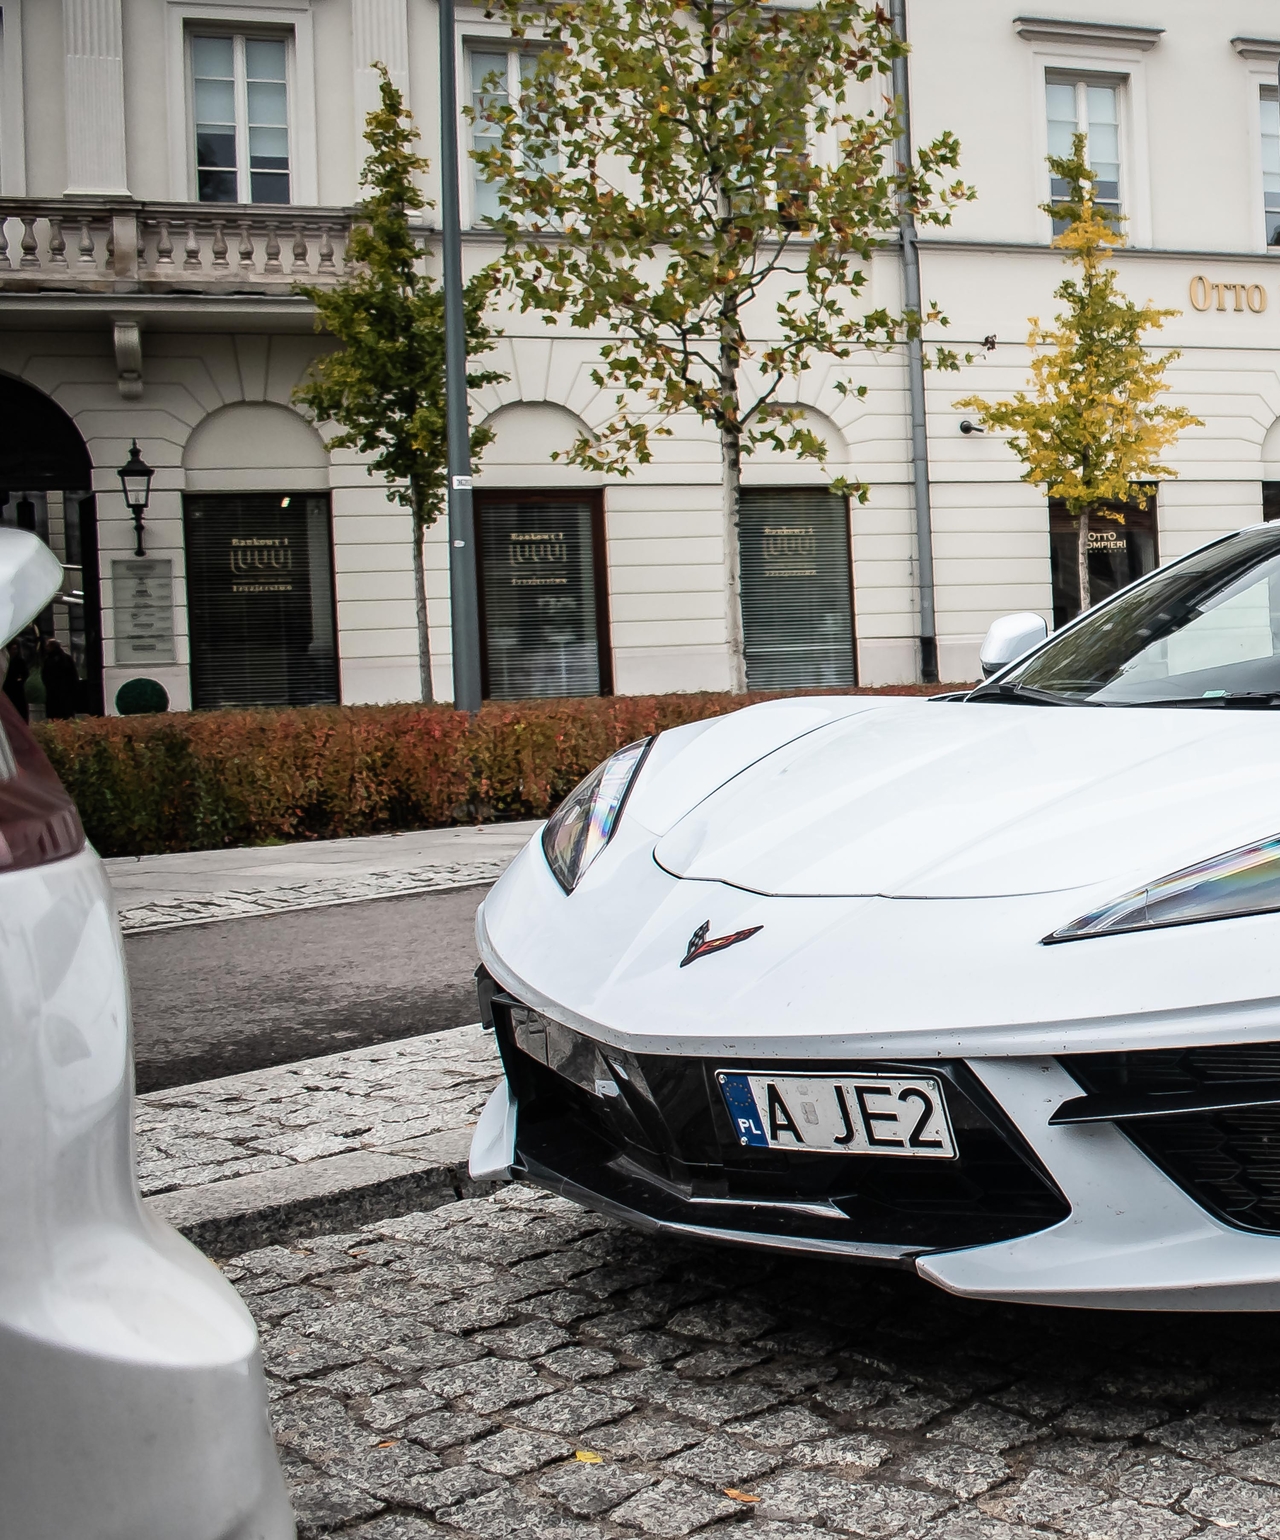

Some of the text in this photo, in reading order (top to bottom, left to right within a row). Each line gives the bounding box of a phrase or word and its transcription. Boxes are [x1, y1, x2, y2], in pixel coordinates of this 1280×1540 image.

[1189, 275, 1267, 314] OTTO
[1087, 531, 1117, 541] OTTO
[1086, 539, 1127, 549] OMPIERI
[737, 1118, 762, 1135] PL
